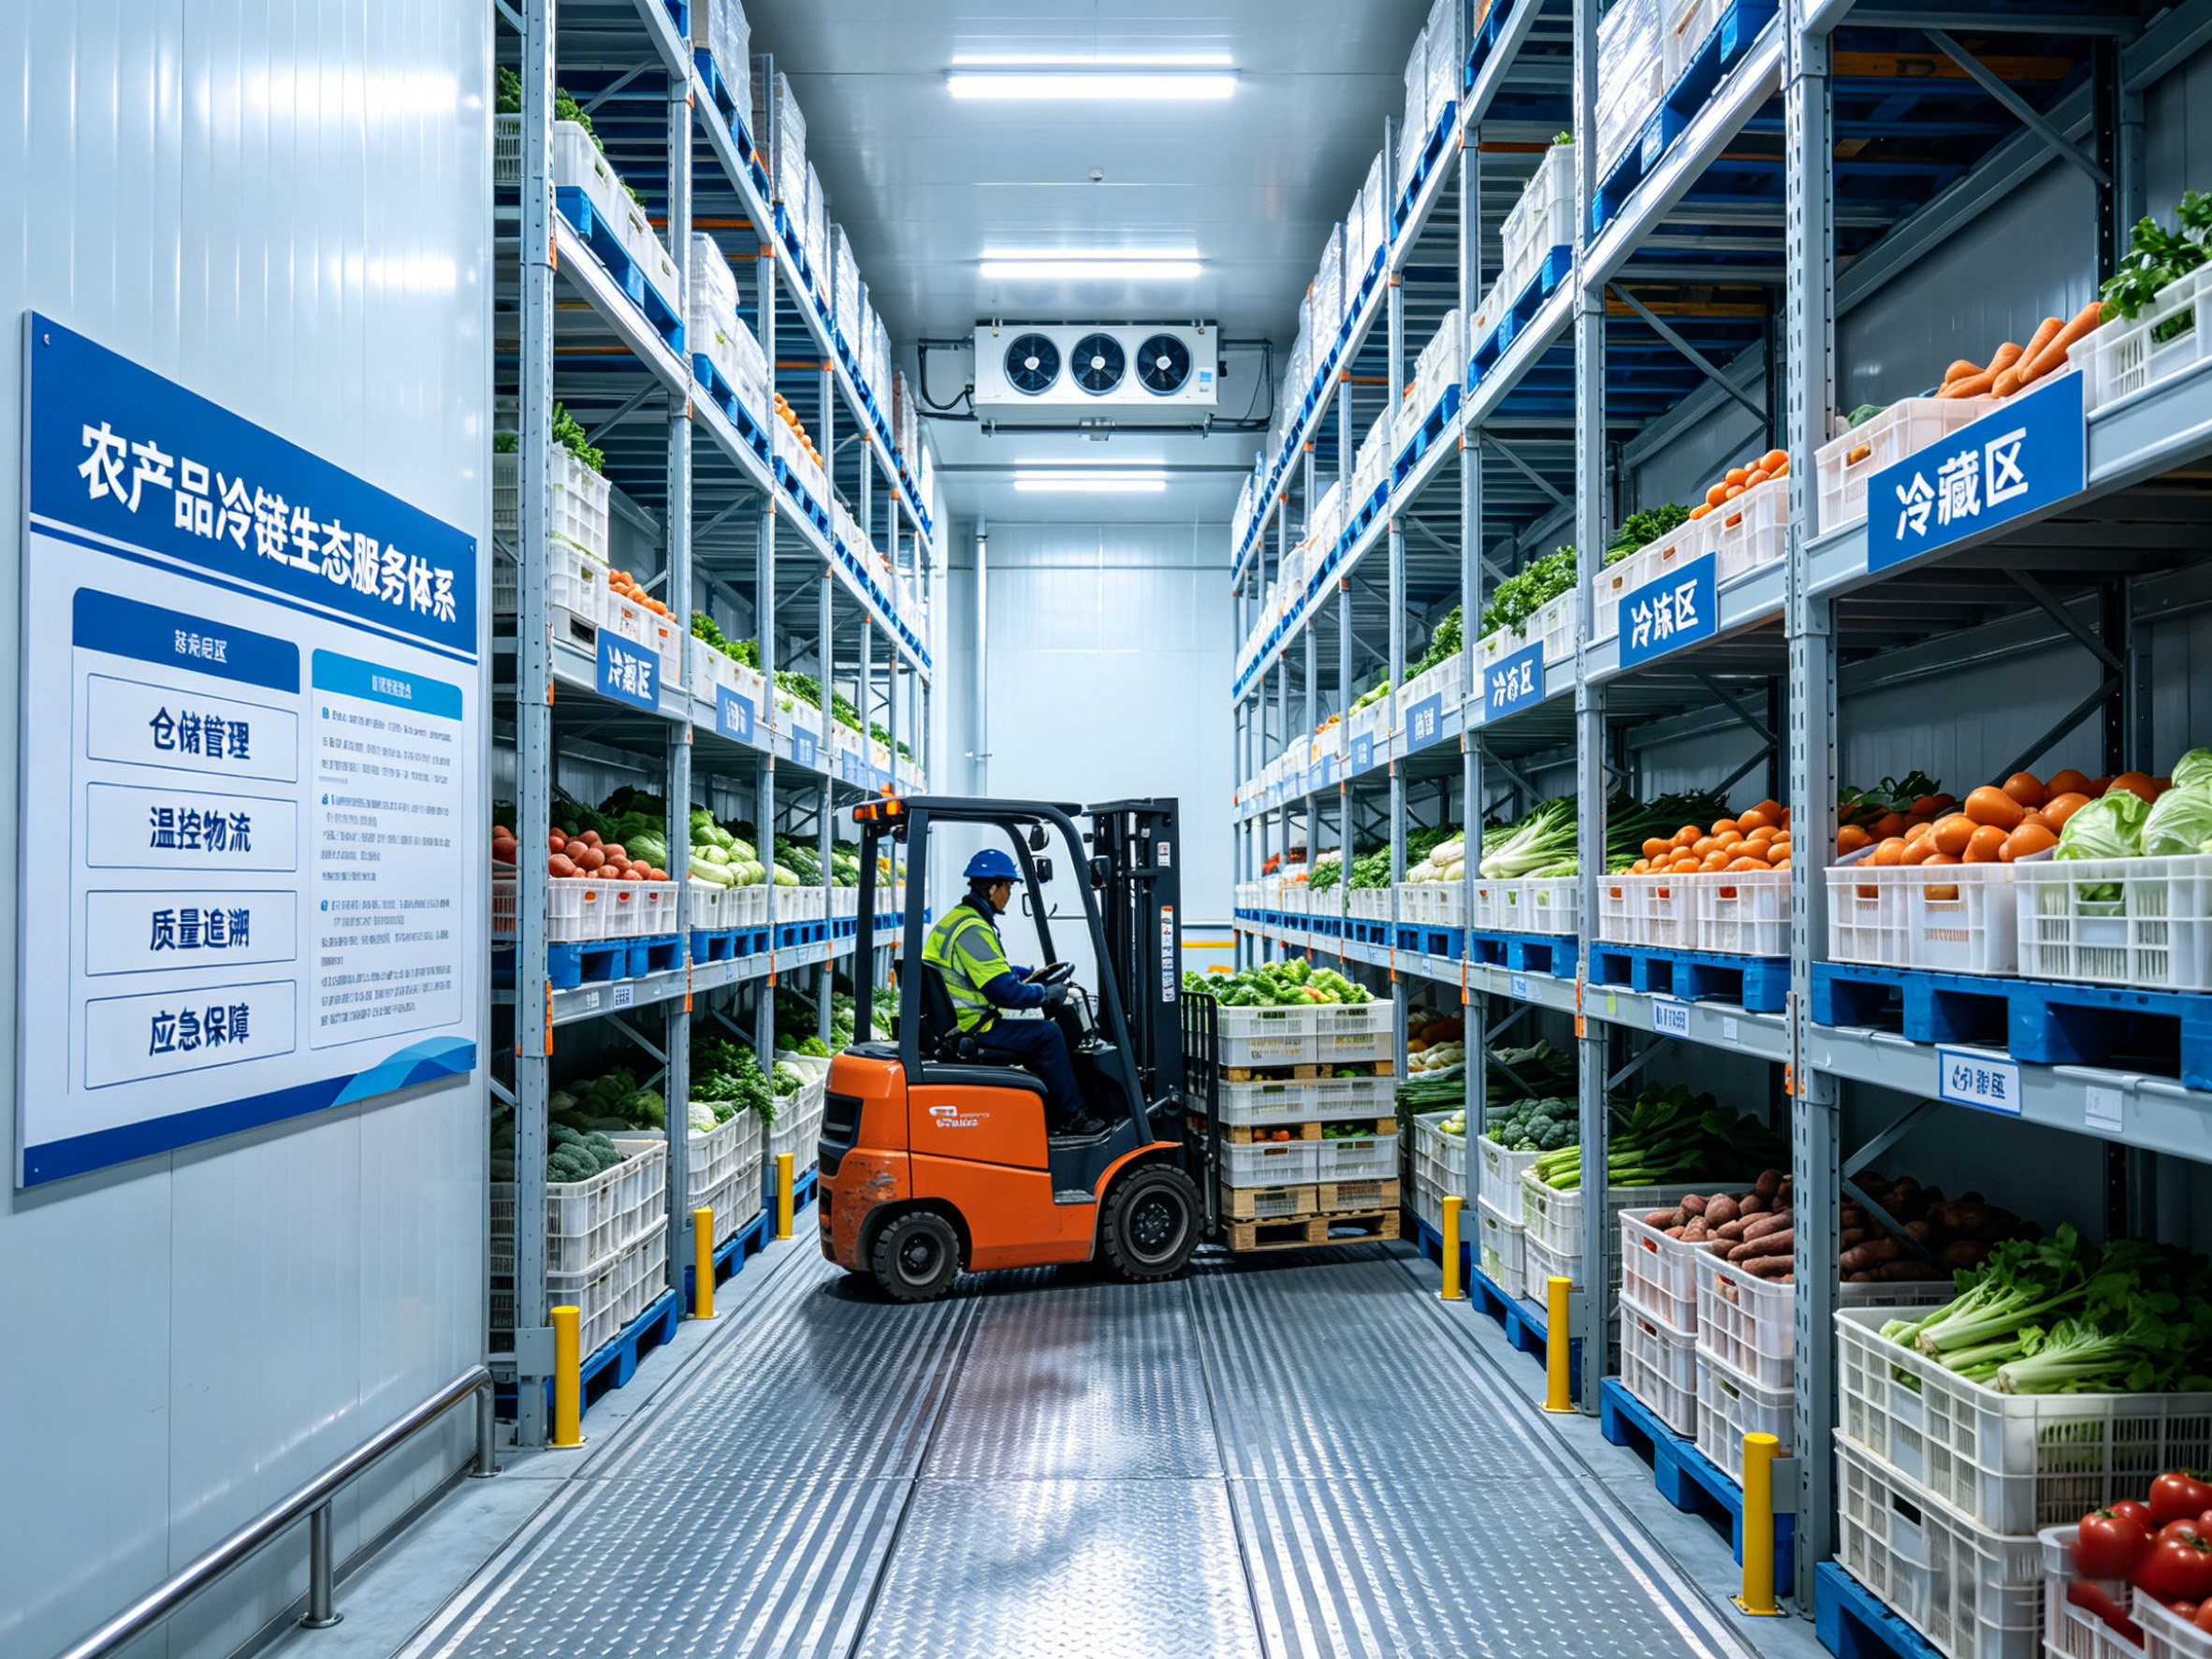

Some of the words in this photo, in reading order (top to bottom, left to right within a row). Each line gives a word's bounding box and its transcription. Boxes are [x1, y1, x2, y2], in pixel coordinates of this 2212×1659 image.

[1895, 427, 2030, 541] 冷藏区
[78, 422, 457, 622] 农产品冷链生态服务体系
[149, 706, 252, 760] 仓储管理
[149, 806, 252, 852] 温控物流
[149, 1001, 251, 1056] 应急保障
